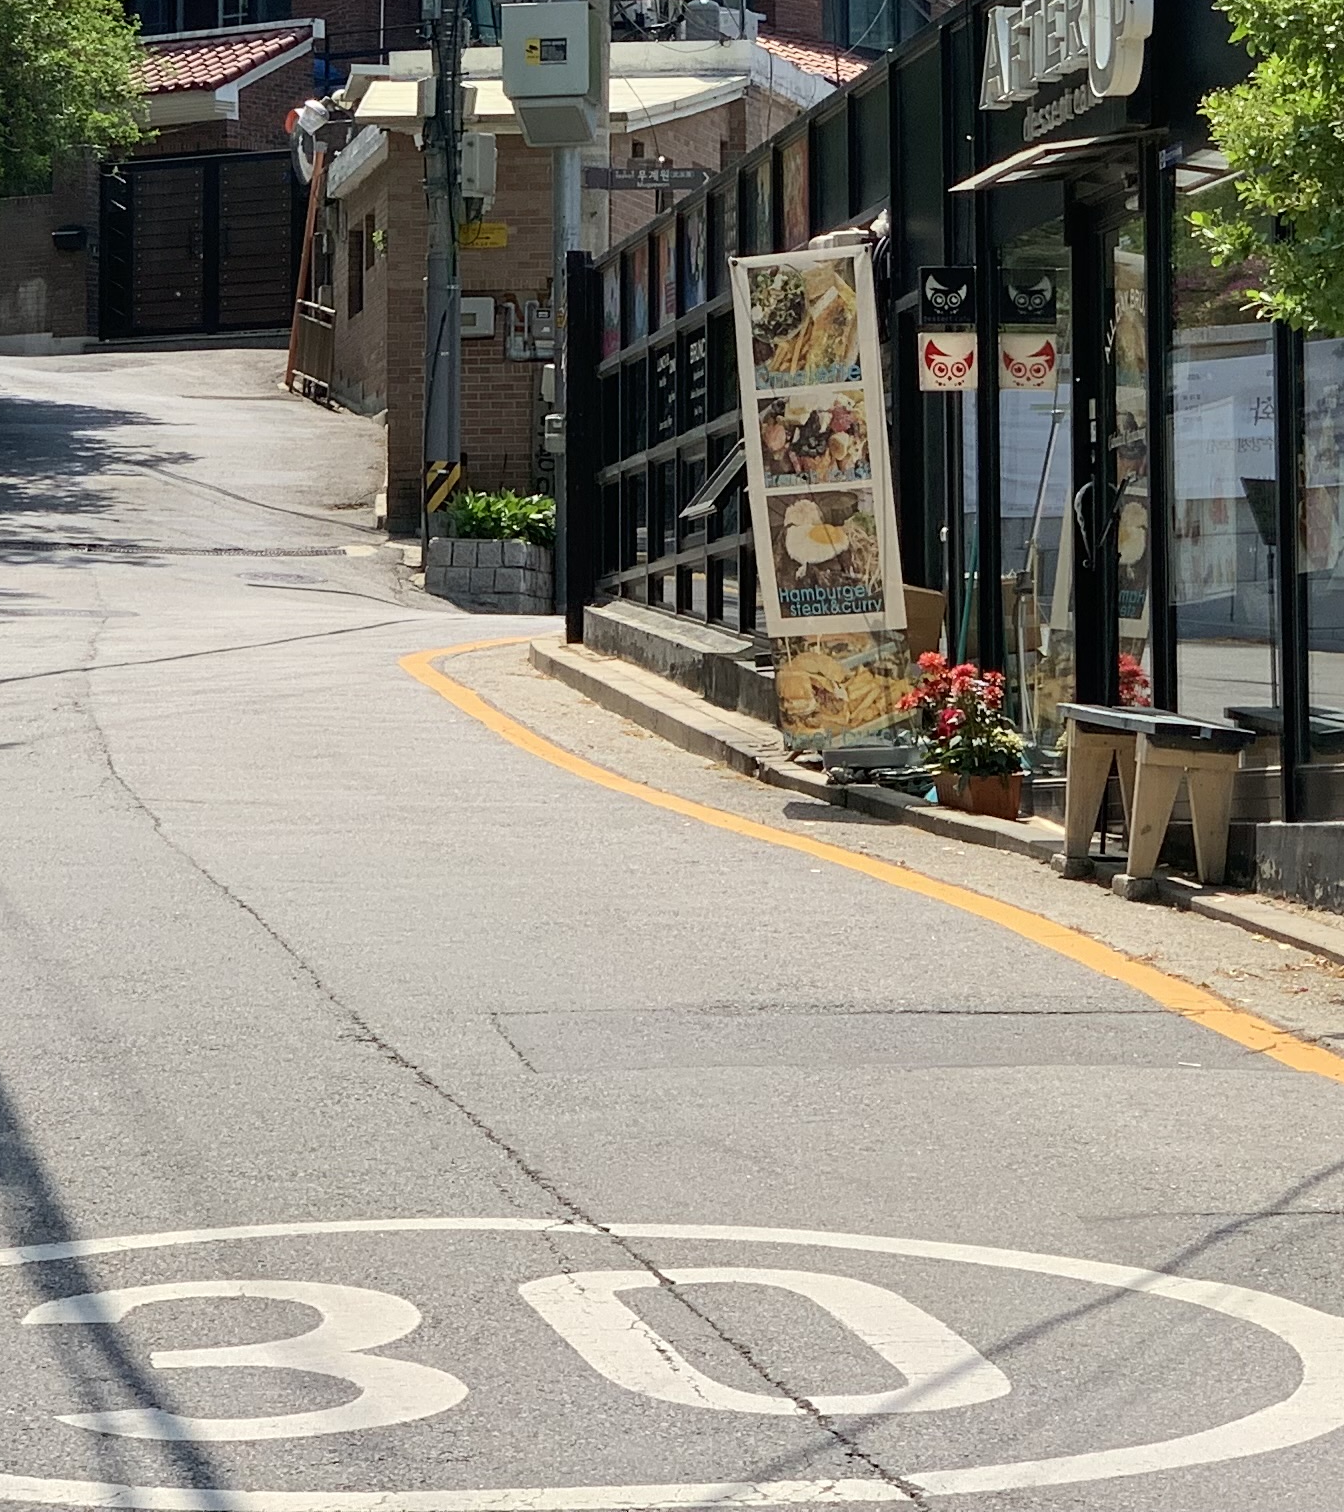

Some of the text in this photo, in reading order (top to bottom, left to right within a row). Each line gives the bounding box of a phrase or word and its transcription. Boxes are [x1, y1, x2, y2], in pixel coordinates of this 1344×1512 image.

[778, 583, 871, 604] Hamburger
[789, 597, 883, 617] steak&curry
[22, 1267, 1012, 1443] 30
